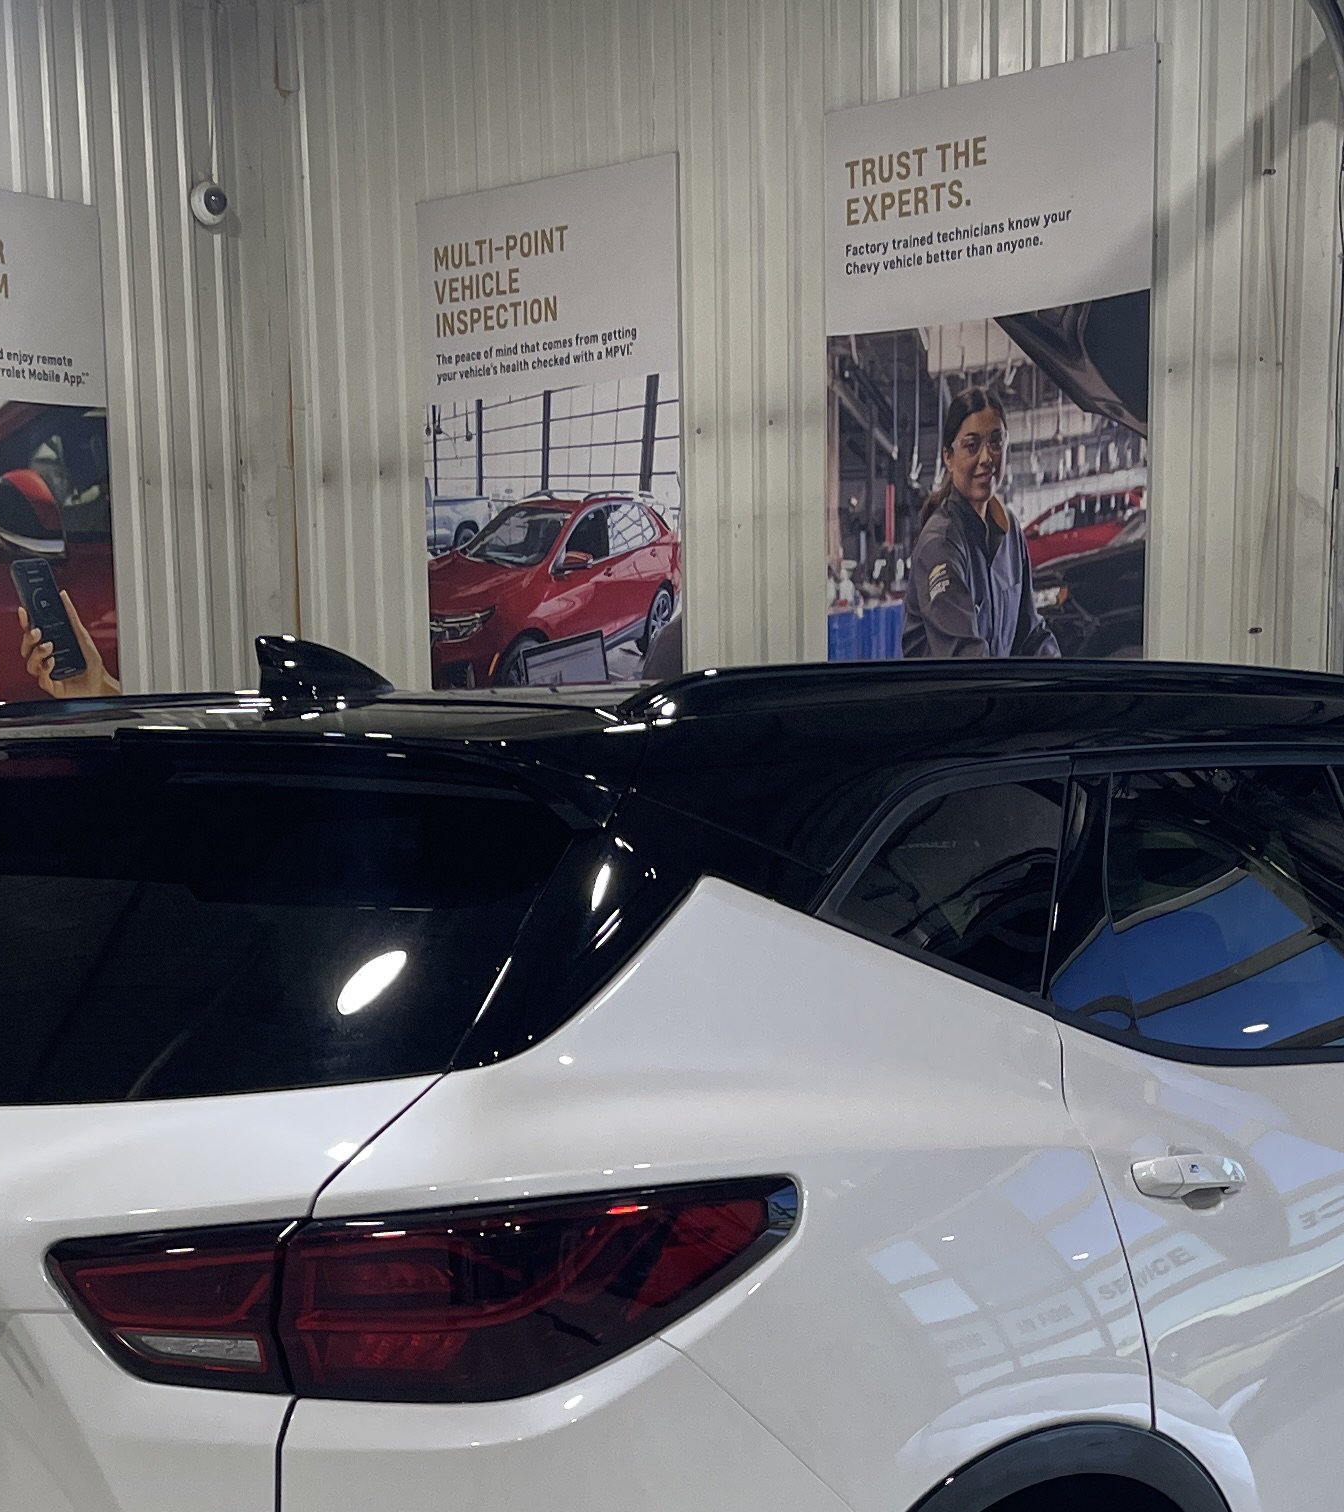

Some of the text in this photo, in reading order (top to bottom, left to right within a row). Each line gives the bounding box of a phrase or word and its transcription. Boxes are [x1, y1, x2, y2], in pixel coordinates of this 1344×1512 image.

[844, 135, 987, 189] TRUST THE
[846, 179, 971, 227] EXPERTS.
[433, 225, 568, 272] MULTI-POINT
[845, 209, 1072, 258] Factory trained technicians know your
[845, 236, 1044, 276] Chevy vehicle better than anyone.
[433, 267, 520, 305] VEHICLE
[436, 295, 558, 338] INSPECTION
[6, 350, 34, 366] enjoy
[36, 354, 73, 367] remote
[436, 327, 637, 367] The peace of mind that comes from getting
[28, 367, 60, 383] Mobile
[436, 371, 457, 385] your
[499, 360, 529, 375] health
[531, 353, 571, 370] checked
[573, 350, 595, 364] with
[597, 351, 603, 361] a
